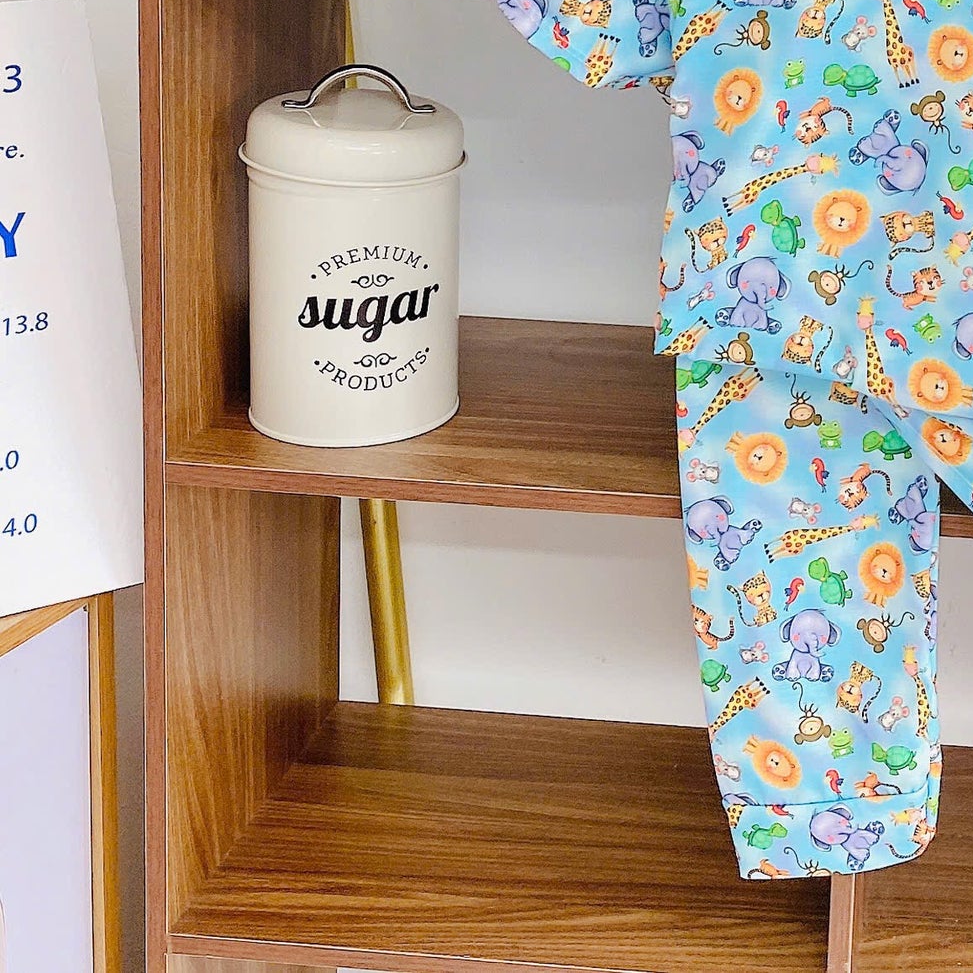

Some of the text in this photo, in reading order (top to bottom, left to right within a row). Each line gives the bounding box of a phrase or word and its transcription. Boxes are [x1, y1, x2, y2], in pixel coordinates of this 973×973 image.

[3, 64, 22, 94] 3
[318, 245, 422, 276] PREMIUM
[2, 311, 49, 336] 13.8
[298, 283, 440, 343] sugar
[319, 350, 427, 392] PRODUCTS
[2, 513, 38, 538] 4.0
